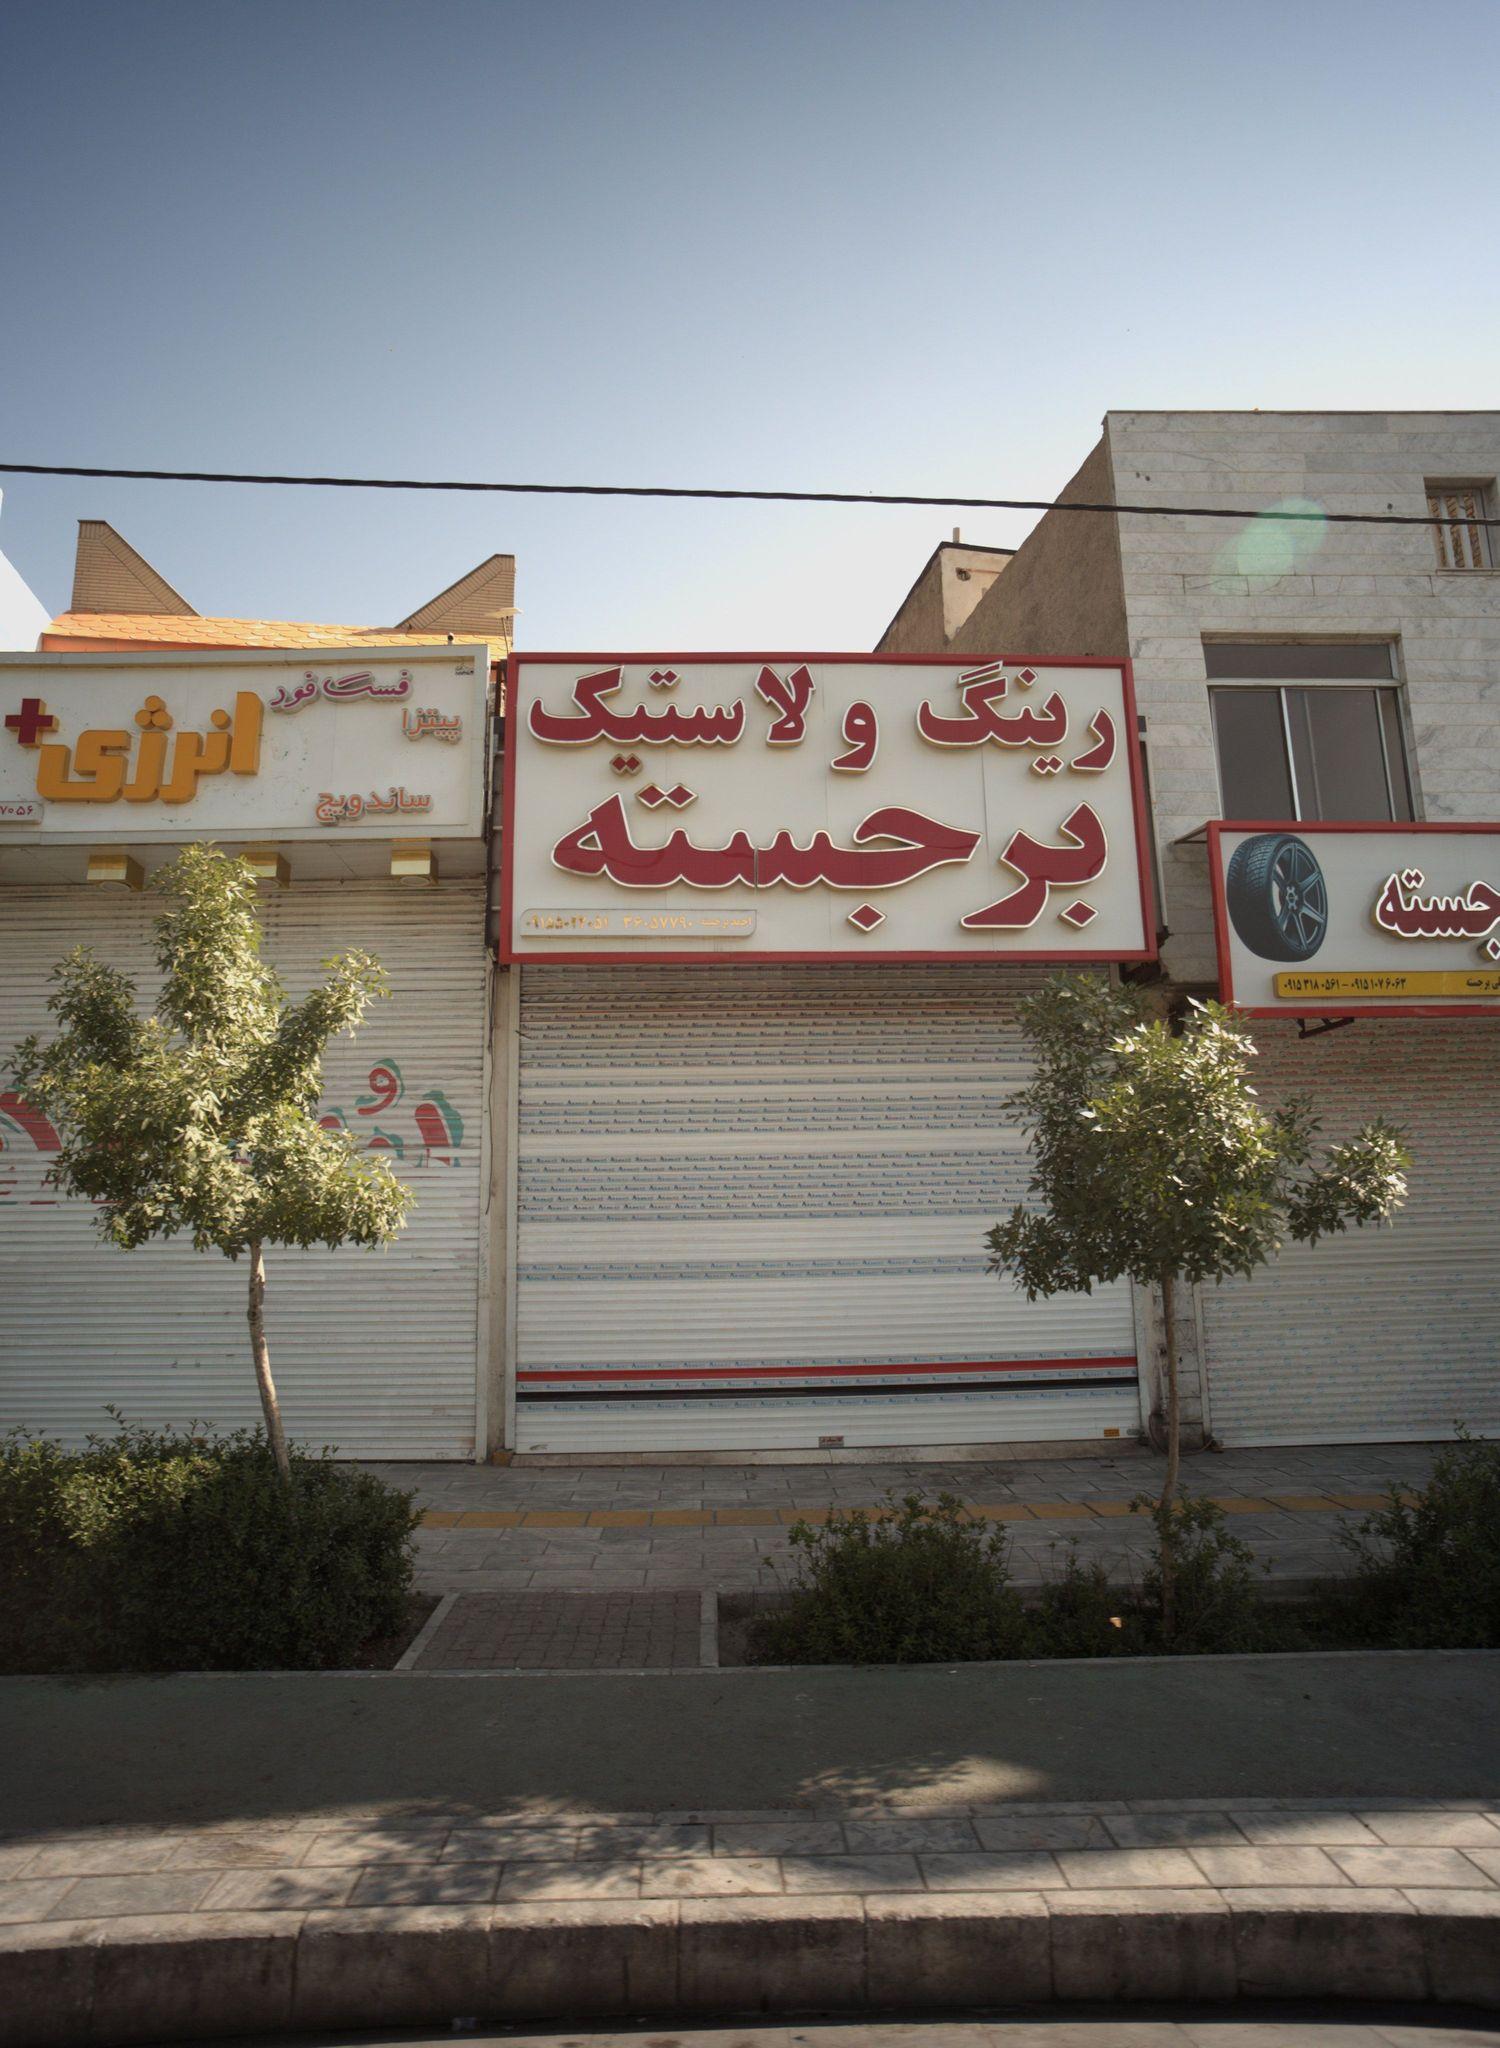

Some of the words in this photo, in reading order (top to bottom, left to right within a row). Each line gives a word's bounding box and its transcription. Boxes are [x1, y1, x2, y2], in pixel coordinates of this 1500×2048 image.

[269, 671, 318, 713] فود
[322, 669, 412, 702] فست
[528, 663, 816, 775] لاستیک
[917, 661, 1117, 774] رینگ
[36, 691, 264, 804] انرژی
[401, 707, 463, 744] پیتزا
[830, 700, 880, 773] و
[315, 786, 433, 824] ساندویچ
[551, 782, 1110, 932] برجسته
